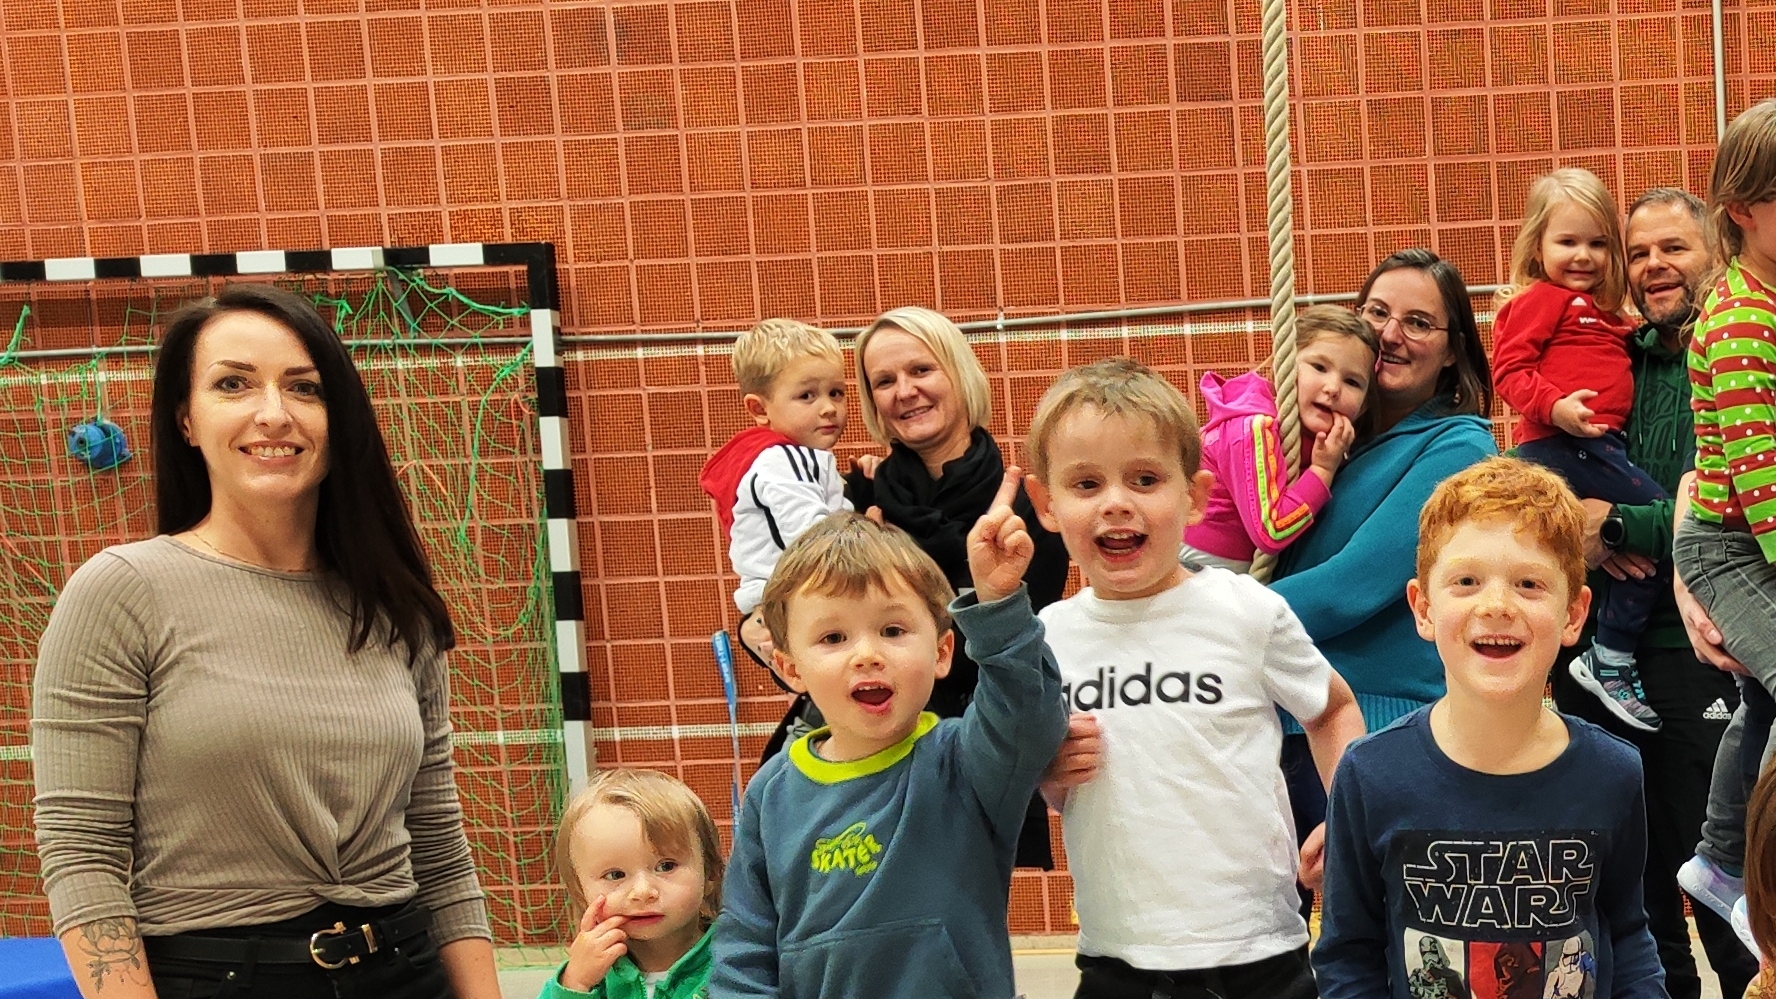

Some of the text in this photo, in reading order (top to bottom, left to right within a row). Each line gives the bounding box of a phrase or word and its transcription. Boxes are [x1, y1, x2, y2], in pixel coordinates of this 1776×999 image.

[1702, 709, 1732, 720] adidas
[1403, 838, 1594, 885] STAR
[1405, 879, 1591, 929] WARS
